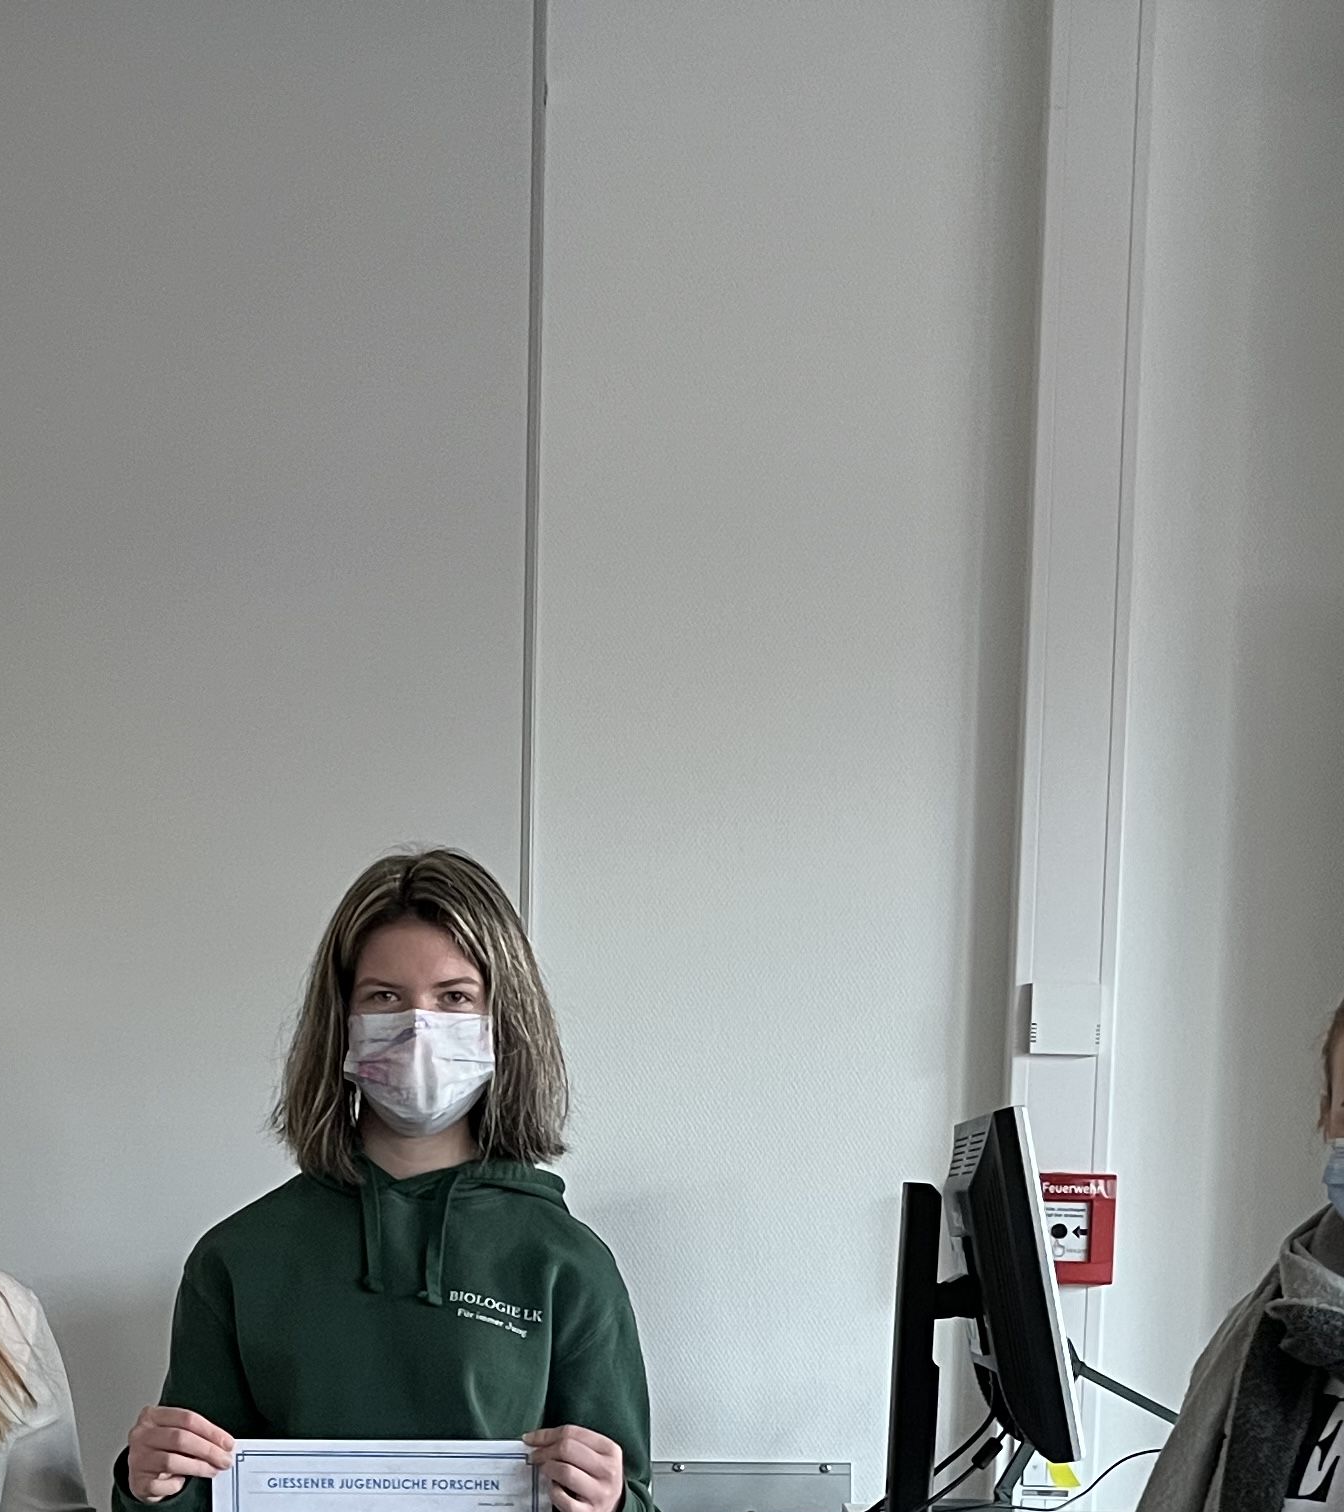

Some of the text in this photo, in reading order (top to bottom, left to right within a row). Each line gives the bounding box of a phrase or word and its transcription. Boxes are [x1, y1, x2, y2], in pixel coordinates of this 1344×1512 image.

[449, 1290, 543, 1322] BIOLOGIE LK
[267, 1477, 500, 1491] GIESSENER JUGENDLICHE FORSCHEN
